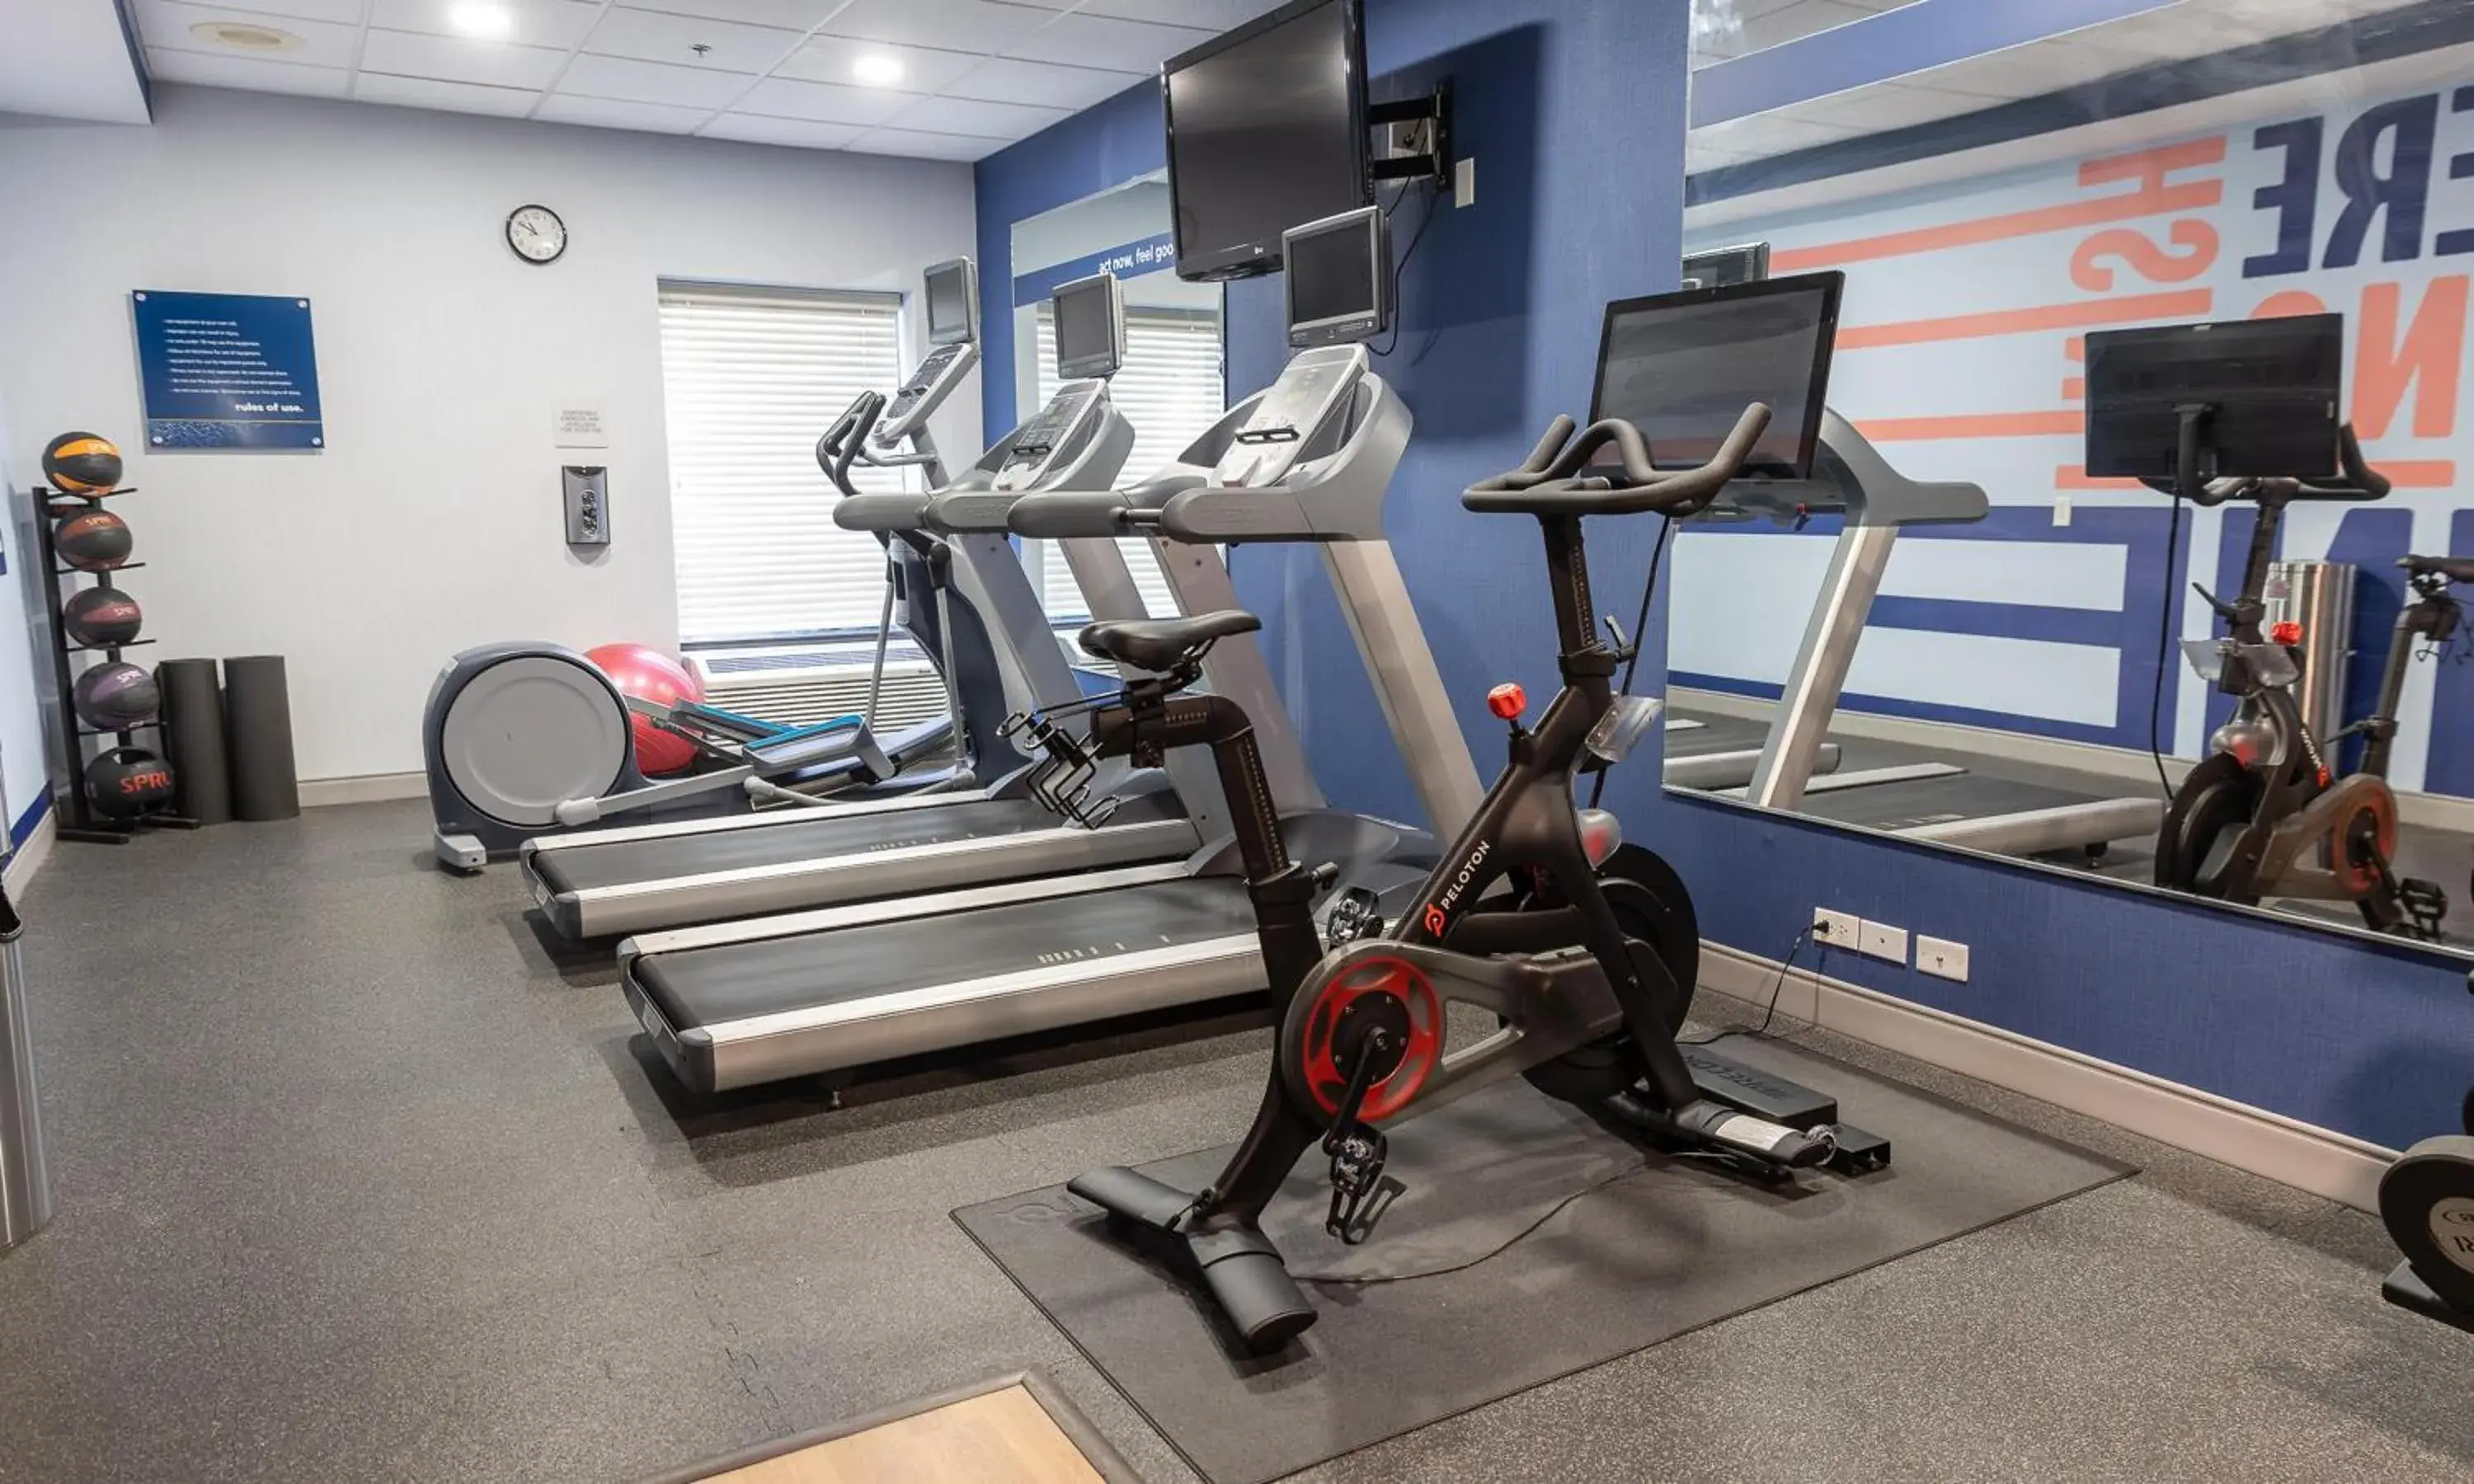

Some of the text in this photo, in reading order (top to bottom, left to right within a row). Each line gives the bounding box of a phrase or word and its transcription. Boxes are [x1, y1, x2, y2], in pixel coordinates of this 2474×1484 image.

[1136, 244, 1154, 264] feel
[1155, 242, 1175, 263] goo
[235, 402, 304, 412] rules of use.
[1440, 840, 1490, 910] PELOTON
